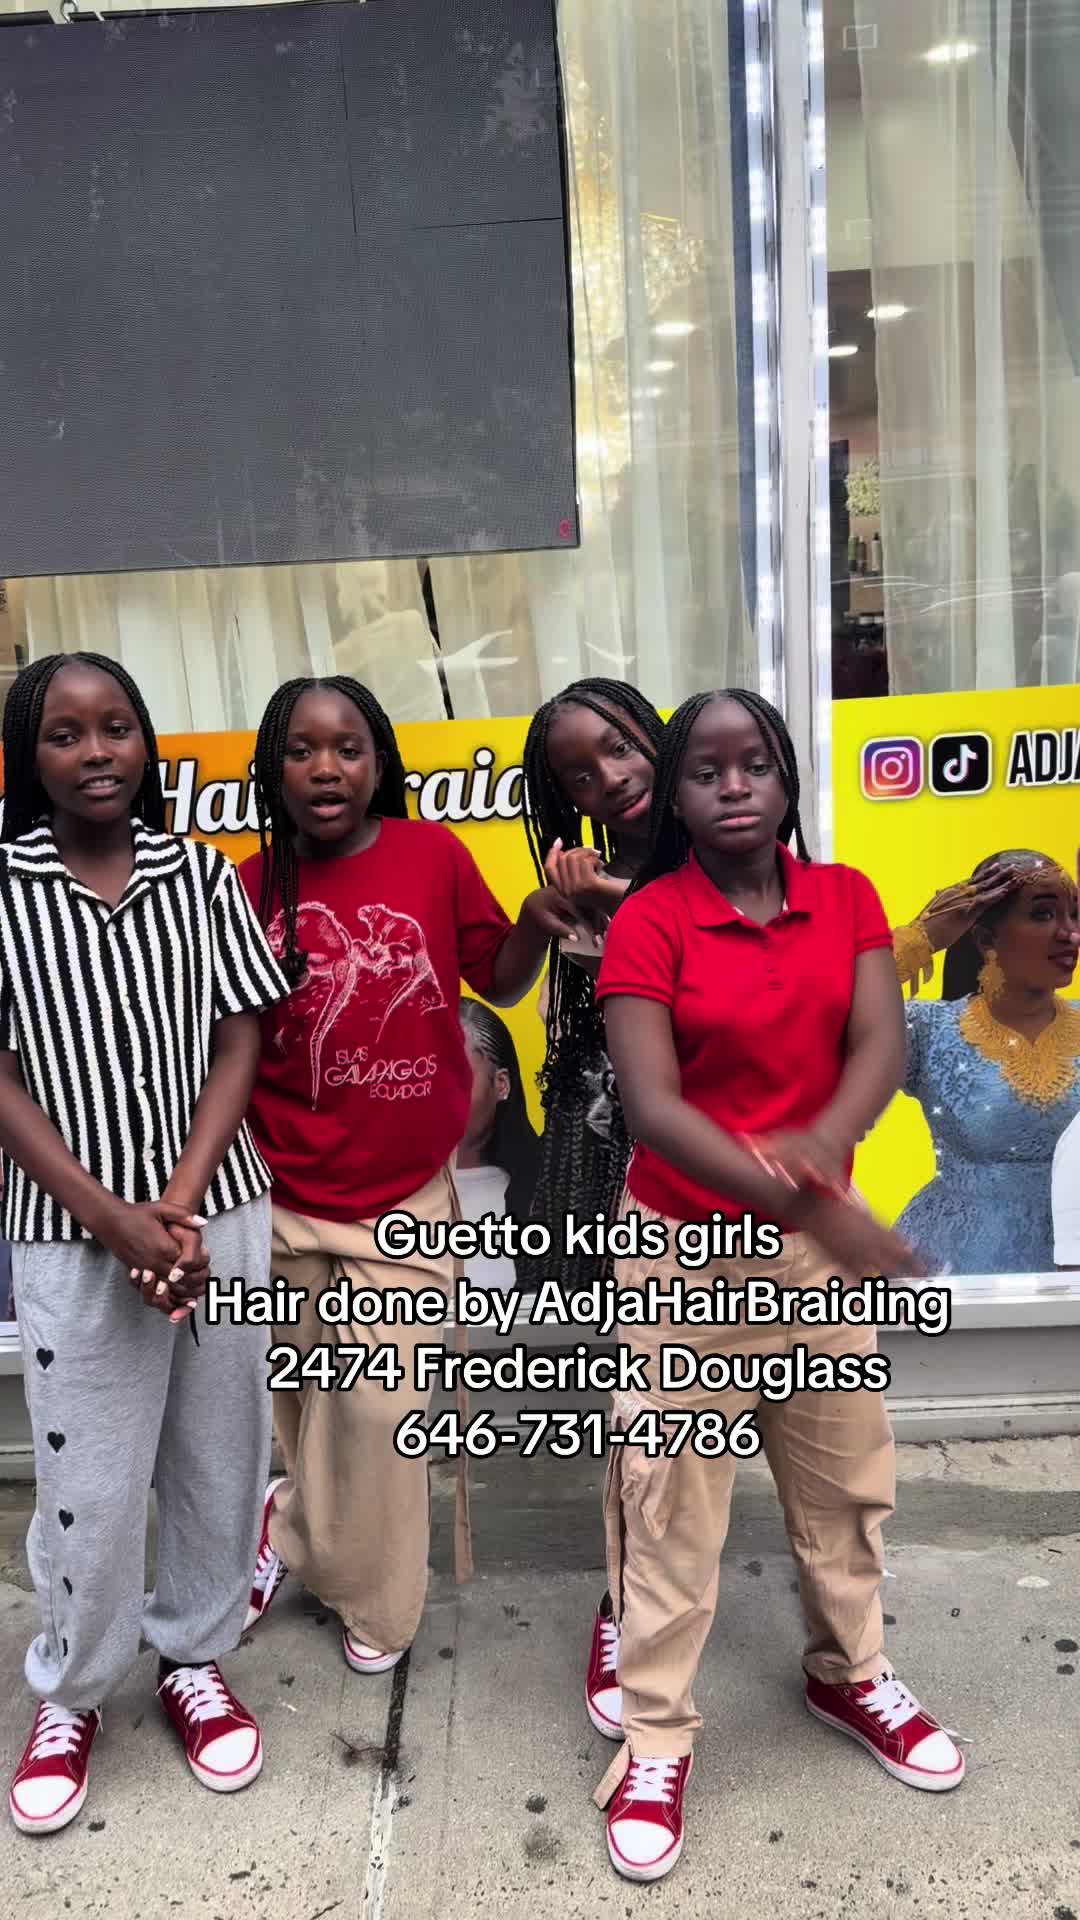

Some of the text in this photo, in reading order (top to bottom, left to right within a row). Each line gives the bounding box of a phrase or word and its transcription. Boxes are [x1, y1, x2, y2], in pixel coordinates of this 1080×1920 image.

[1006, 729, 1080, 787] ADJ
[324, 1053, 438, 1087] GALAPAGOS
[369, 1080, 432, 1101] ECUADOR
